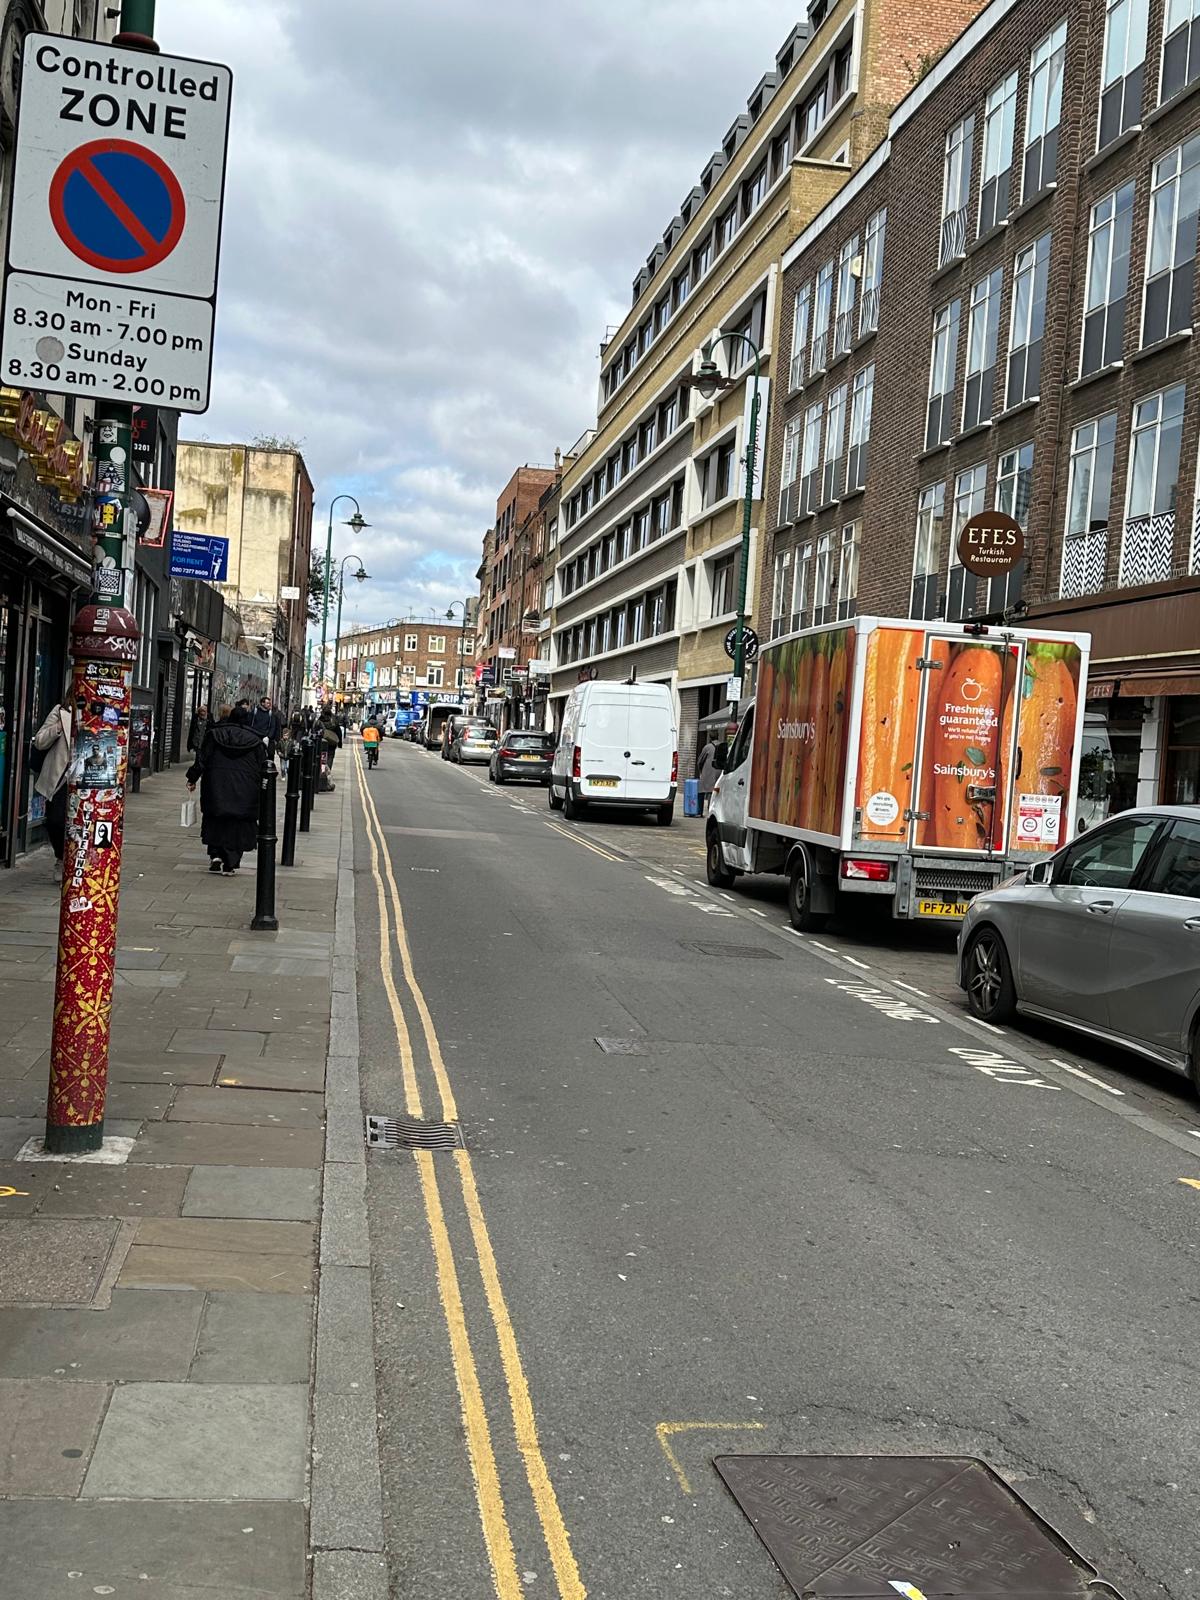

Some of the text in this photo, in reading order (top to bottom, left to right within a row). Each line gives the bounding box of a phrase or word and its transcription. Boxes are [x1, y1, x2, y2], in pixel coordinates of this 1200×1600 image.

[36, 45, 218, 101] Controlled
[59, 87, 187, 140] ZONE
[66, 290, 111, 313] Mon
[129, 300, 156, 320] Fri
[13, 307, 66, 331] 8.30
[70, 319, 101, 336] am
[117, 322, 167, 346] 7.00
[172, 334, 203, 351] pm
[67, 342, 148, 372] Sunday
[8, 359, 61, 381] 8.30
[65, 370, 97, 386] am
[113, 373, 165, 396] 2.00
[170, 385, 201, 400] pm
[968, 527, 1017, 546] EFES
[172, 555, 204, 567] FOR RENT
[970, 554, 1012, 564] Restaurant
[979, 546, 1005, 556] Turkish
[939, 715, 998, 727] guaranteed
[945, 703, 995, 716] Freshness
[777, 717, 816, 745] Sainsbury's
[933, 763, 996, 780] Sainsbury's
[954, 904, 969, 914] NL
[824, 978, 941, 1024] LOADING
[948, 1047, 1062, 1091] ONLY
